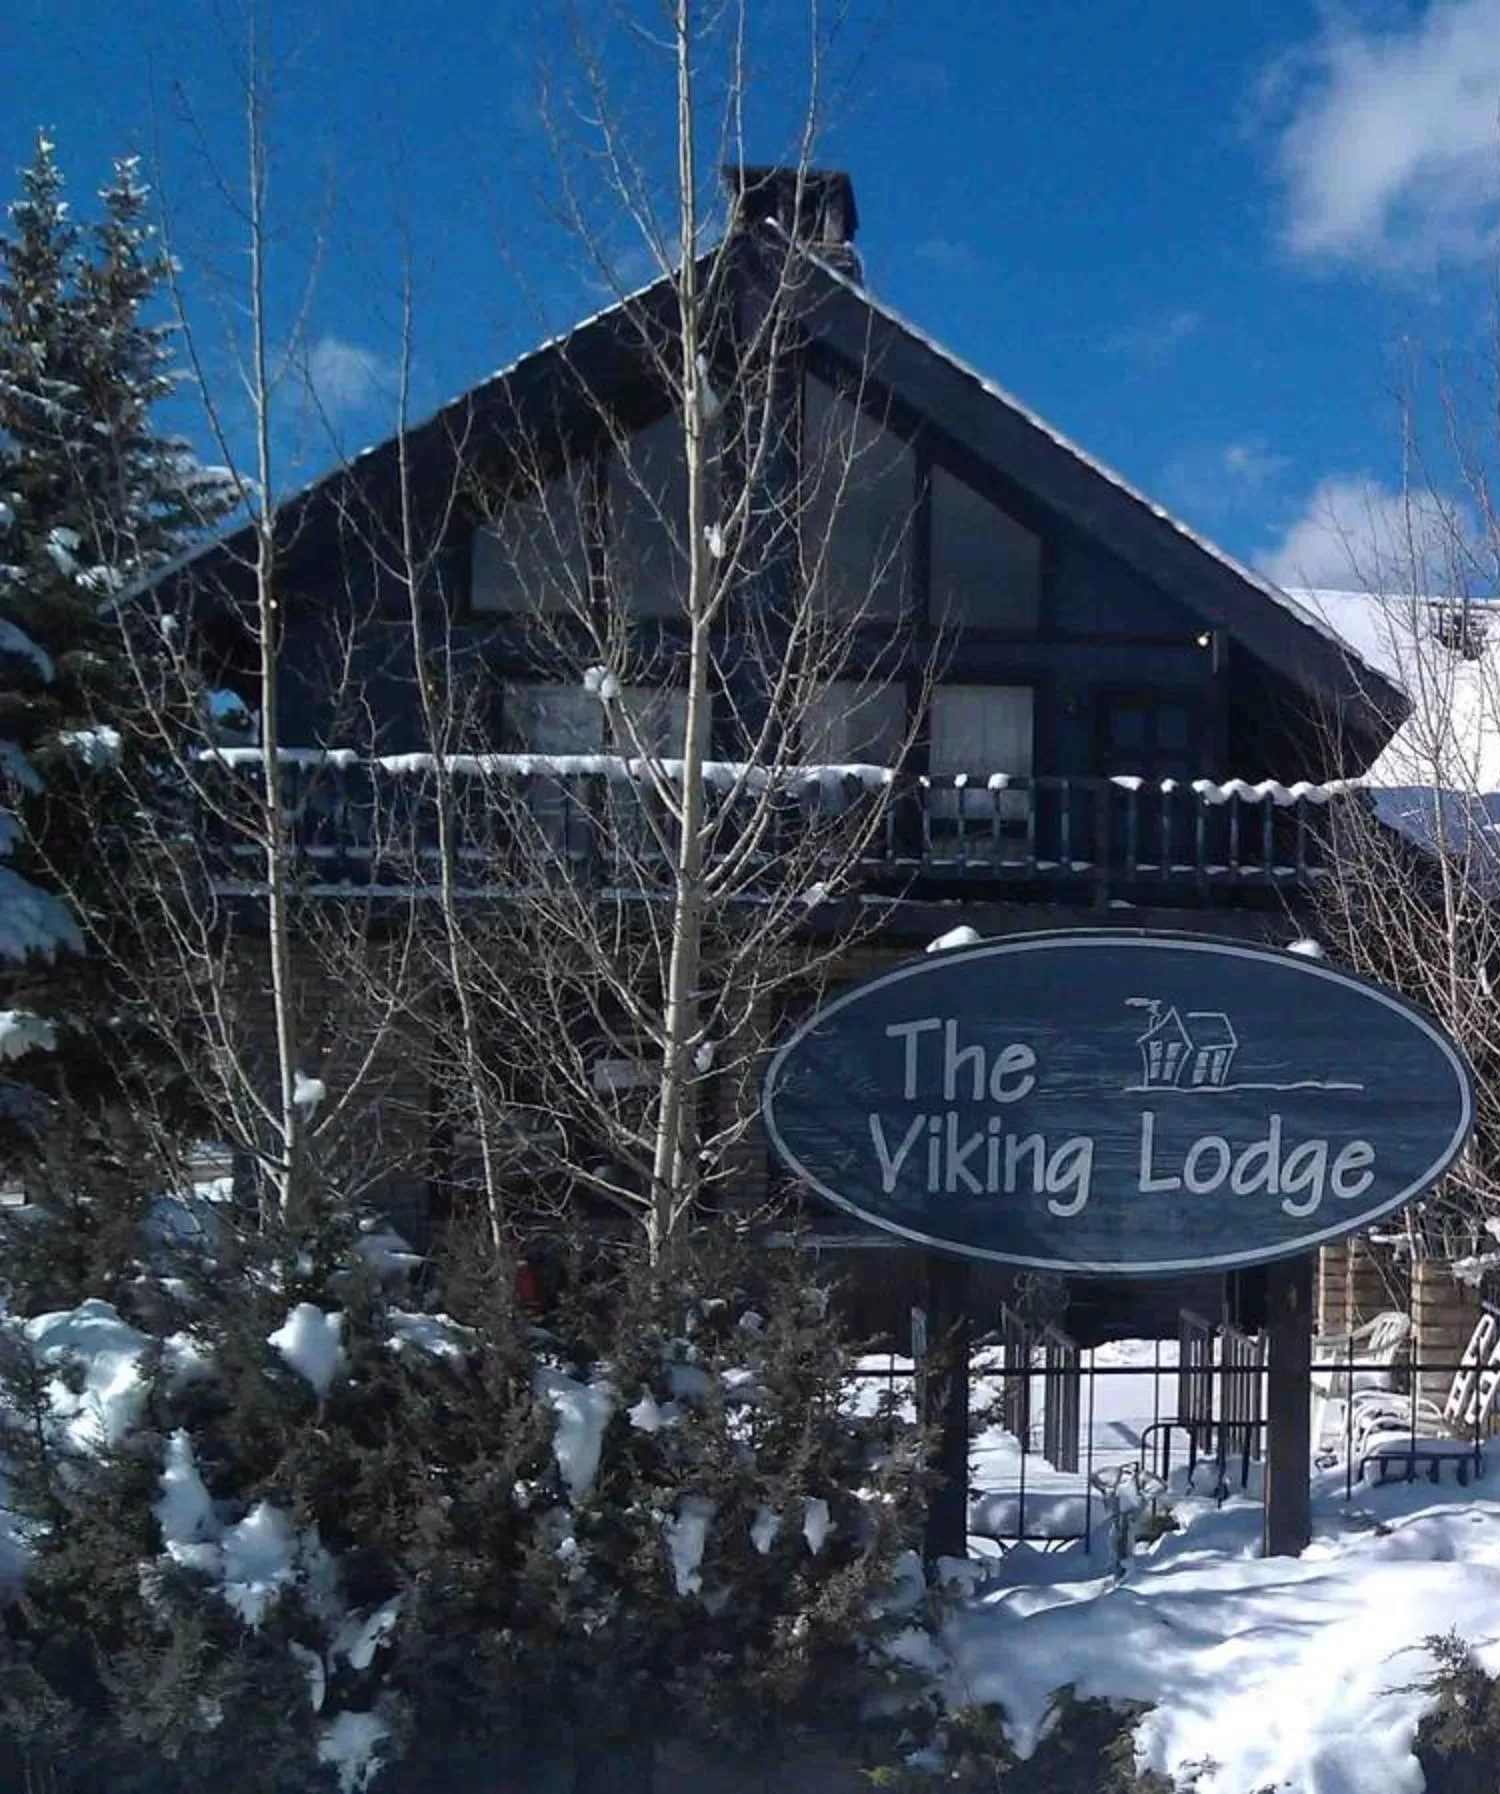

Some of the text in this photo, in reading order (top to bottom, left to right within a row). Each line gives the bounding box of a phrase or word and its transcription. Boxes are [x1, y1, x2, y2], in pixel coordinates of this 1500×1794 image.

[886, 1018, 1036, 1102] The
[869, 1111, 1375, 1217] Viking Lodge
